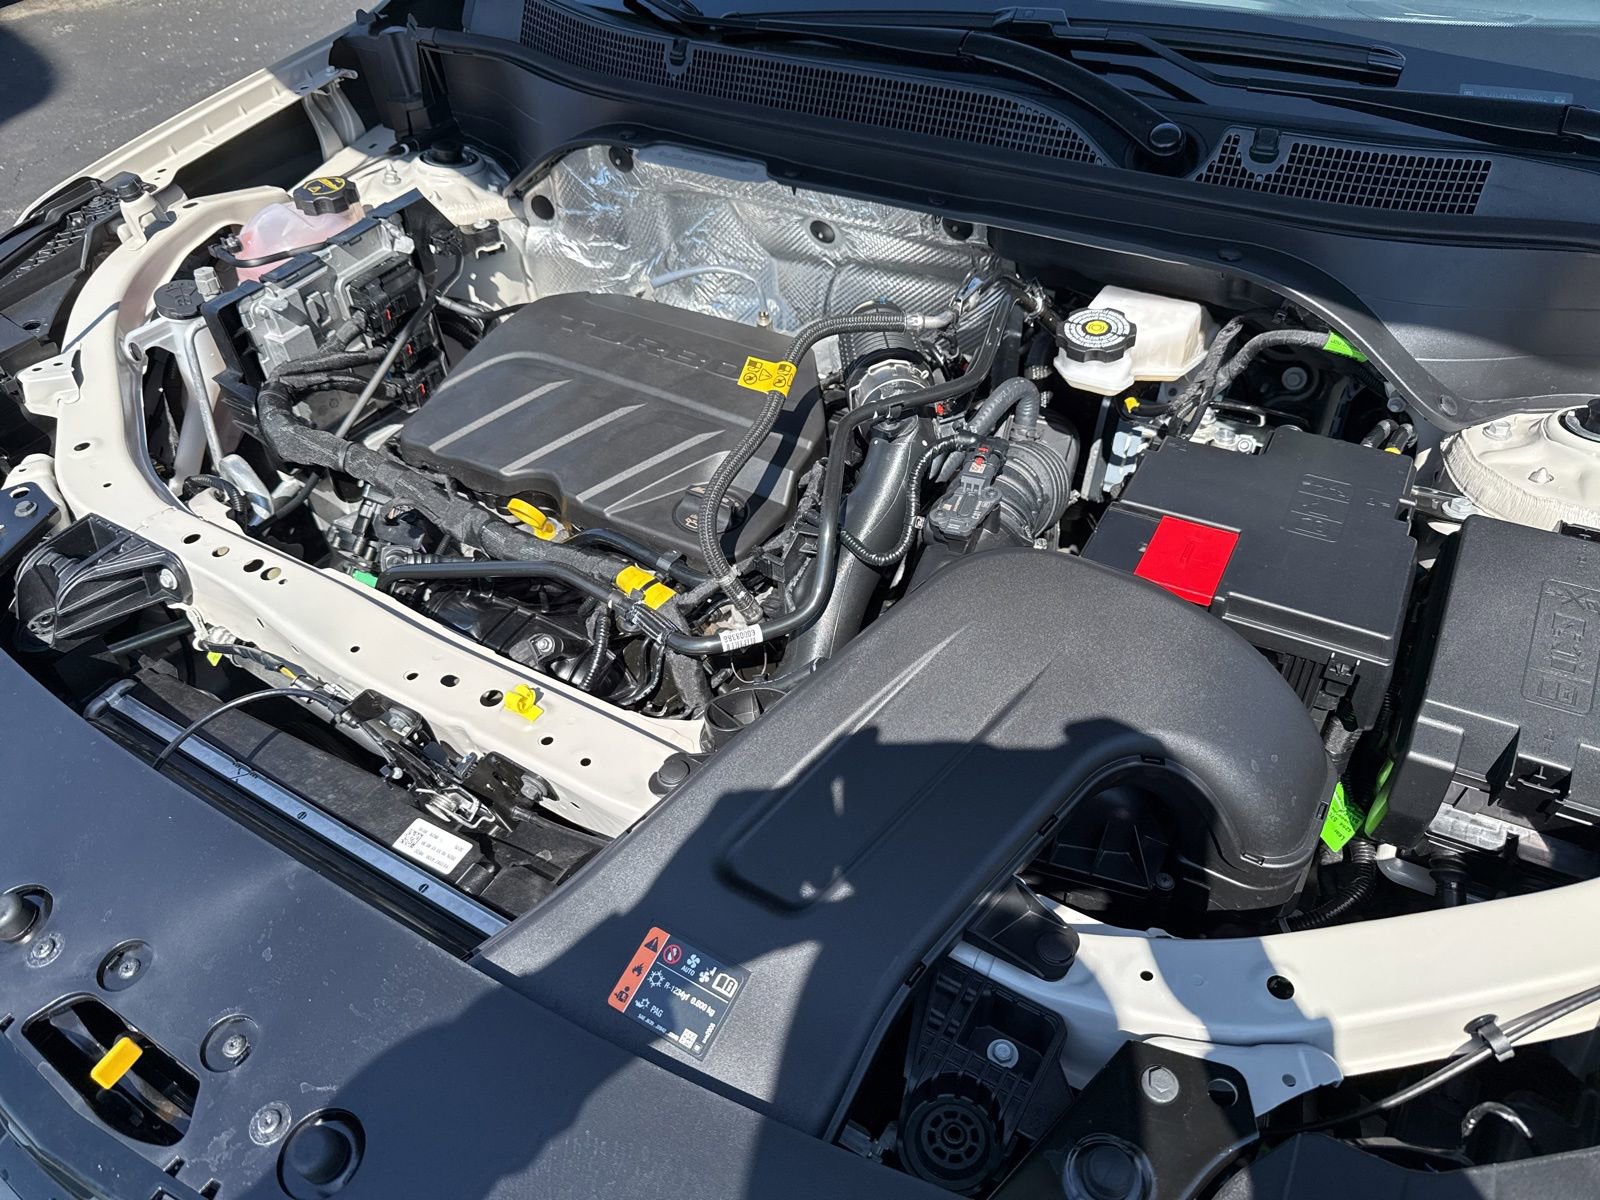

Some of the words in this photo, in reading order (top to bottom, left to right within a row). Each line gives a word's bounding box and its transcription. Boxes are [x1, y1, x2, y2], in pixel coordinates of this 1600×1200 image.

[681, 964, 695, 976] AUTO
[664, 982, 690, 1001] R-1234yf
[706, 1006, 716, 1017] kg
[650, 1005, 663, 1017] PAG
